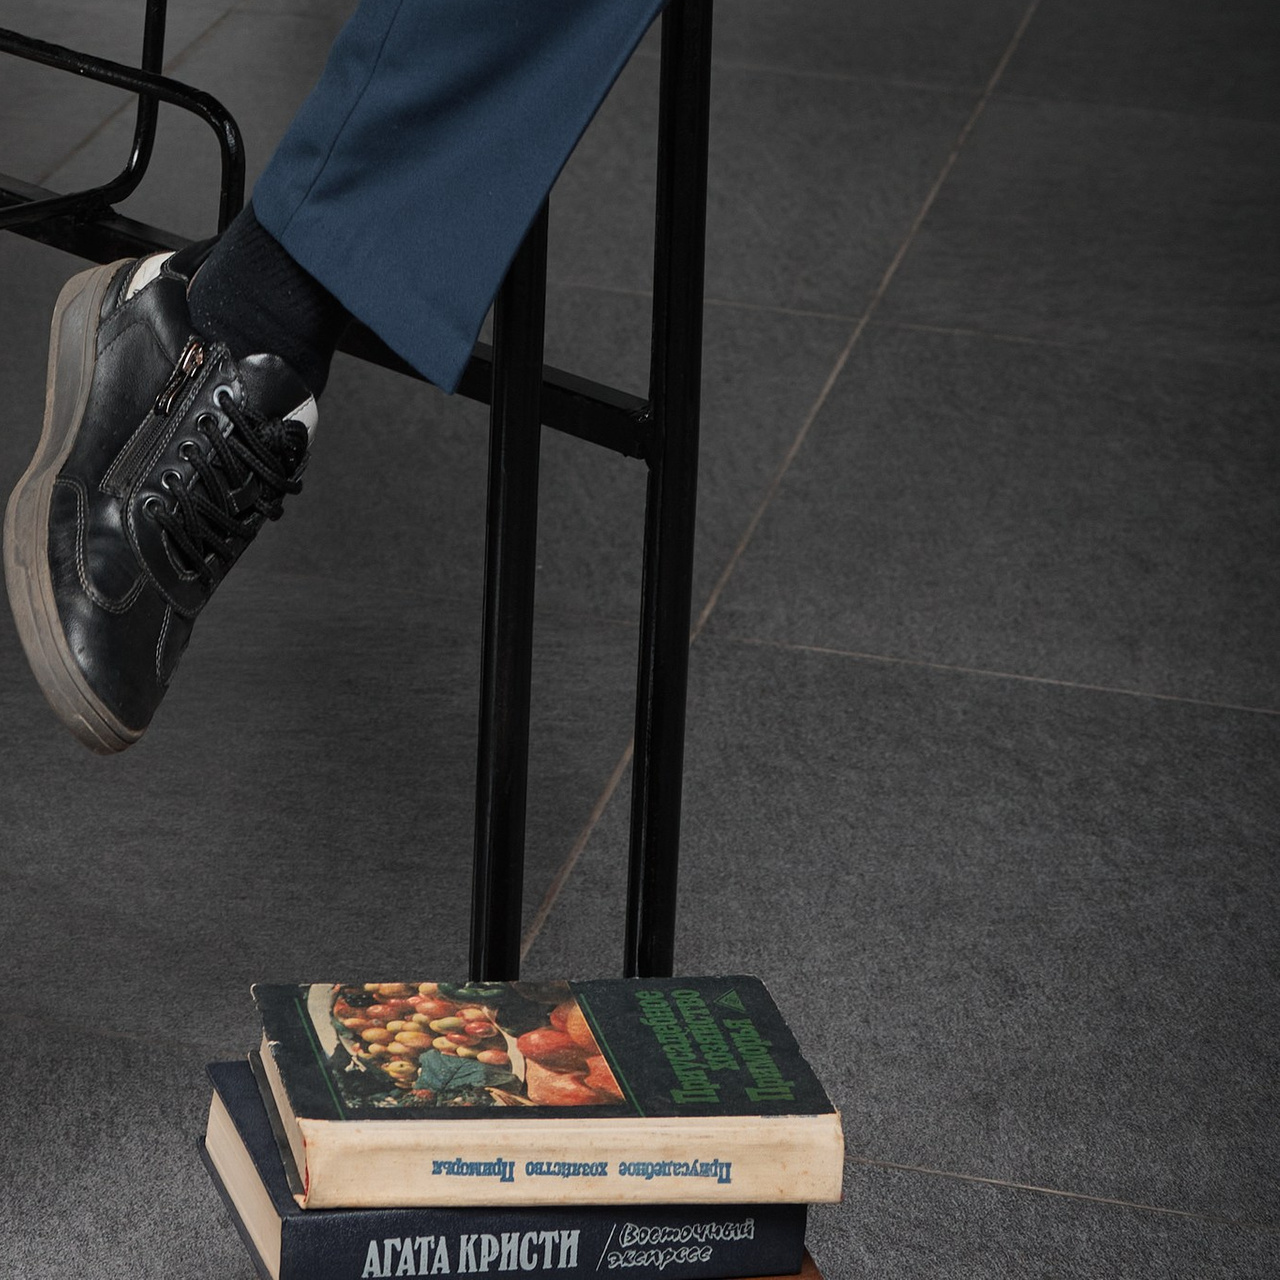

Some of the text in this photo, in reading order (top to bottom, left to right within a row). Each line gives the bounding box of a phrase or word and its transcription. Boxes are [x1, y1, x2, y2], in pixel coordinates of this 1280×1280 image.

[634, 989, 721, 1105] Приусадебное
[722, 1018, 796, 1102] Приморья
[431, 1157, 732, 1184] Приусадебное хозяйство Приморья
[361, 1217, 756, 1278] АГАТА КРИСТИ Восточный
